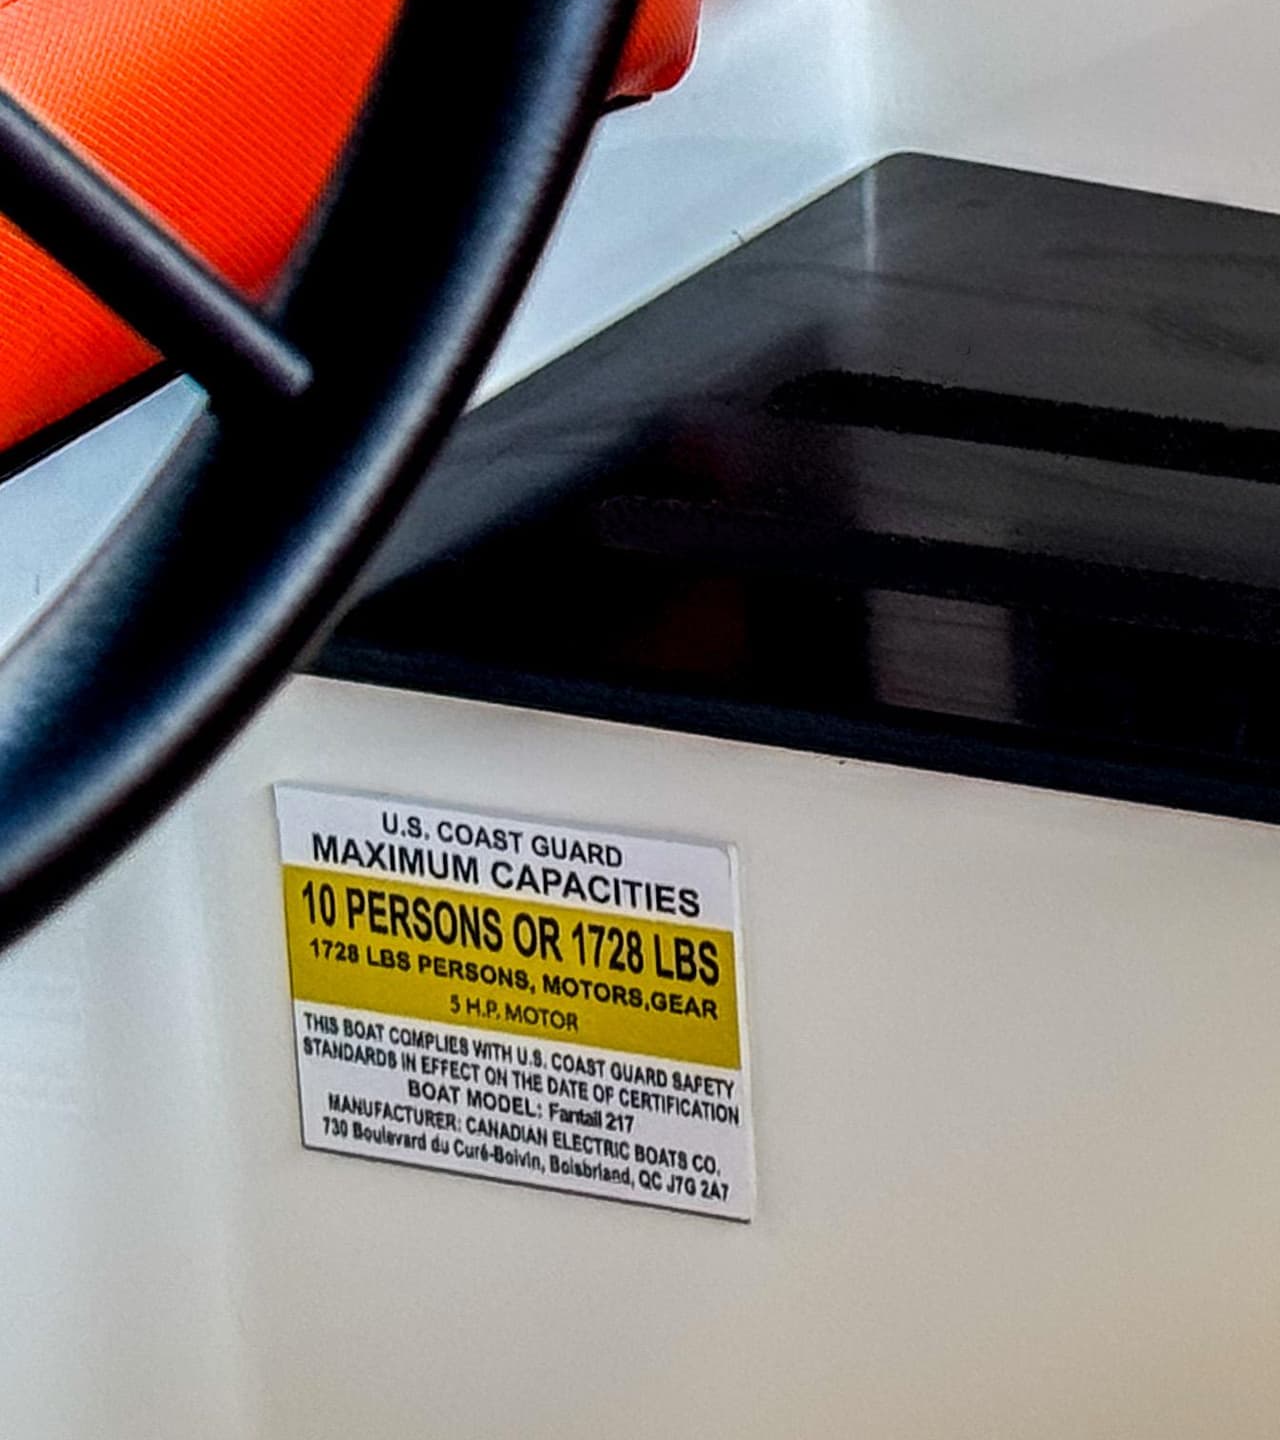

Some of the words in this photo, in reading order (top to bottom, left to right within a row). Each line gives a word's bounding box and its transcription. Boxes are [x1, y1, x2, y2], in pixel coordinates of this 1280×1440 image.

[312, 832, 479, 885] MAXIMUM
[490, 861, 701, 918] CAPACITIES
[382, 811, 430, 841] U.S.
[437, 820, 523, 854] COAST
[531, 835, 623, 868] GUARD
[302, 880, 336, 927] 10
[345, 886, 503, 953] PERSONS
[513, 912, 563, 963] OR
[572, 921, 644, 975] 1728
[653, 933, 720, 987] LBS
[309, 937, 359, 964] 1728
[367, 946, 411, 972] LBS
[418, 954, 536, 994] PERSONS,
[303, 1012, 339, 1035] THIS
[344, 1018, 385, 1041] BOAT
[388, 1026, 469, 1058] COMPLIES
[472, 1039, 513, 1063] WITH
[517, 1045, 547, 1070] U.S.
[551, 1052, 606, 1078] COAST
[610, 1062, 668, 1088] GUARD
[672, 1071, 735, 1099] SAFETY
[450, 994, 461, 1014] 5
[505, 1002, 578, 1033] MOTOR
[303, 1037, 398, 1069] STANDARDS
[401, 1051, 417, 1074] IN
[421, 1056, 481, 1083] EFFECT
[485, 1066, 508, 1088] ON
[512, 1070, 543, 1094] THE
[547, 1076, 588, 1101] DATE
[593, 1084, 614, 1105] OF
[618, 1087, 740, 1126] CERTIFICATION
[408, 1078, 461, 1105] BOAT
[467, 1091, 543, 1119] MODEL:
[548, 1103, 603, 1129] Fantail
[605, 1112, 635, 1134] 217
[322, 1116, 348, 1138] 730
[352, 1121, 427, 1151] Boulevard
[431, 1136, 450, 1156] du
[638, 1169, 663, 1192] QC
[666, 1173, 697, 1197] J7G
[700, 1179, 729, 1203] 2A7
[328, 1091, 462, 1133] MANUFACTURER:
[465, 1116, 548, 1148] CANADIAN
[552, 1130, 630, 1161] ELECTRIC
[634, 1145, 688, 1170] BOATS
[692, 1154, 721, 1178] CO.
